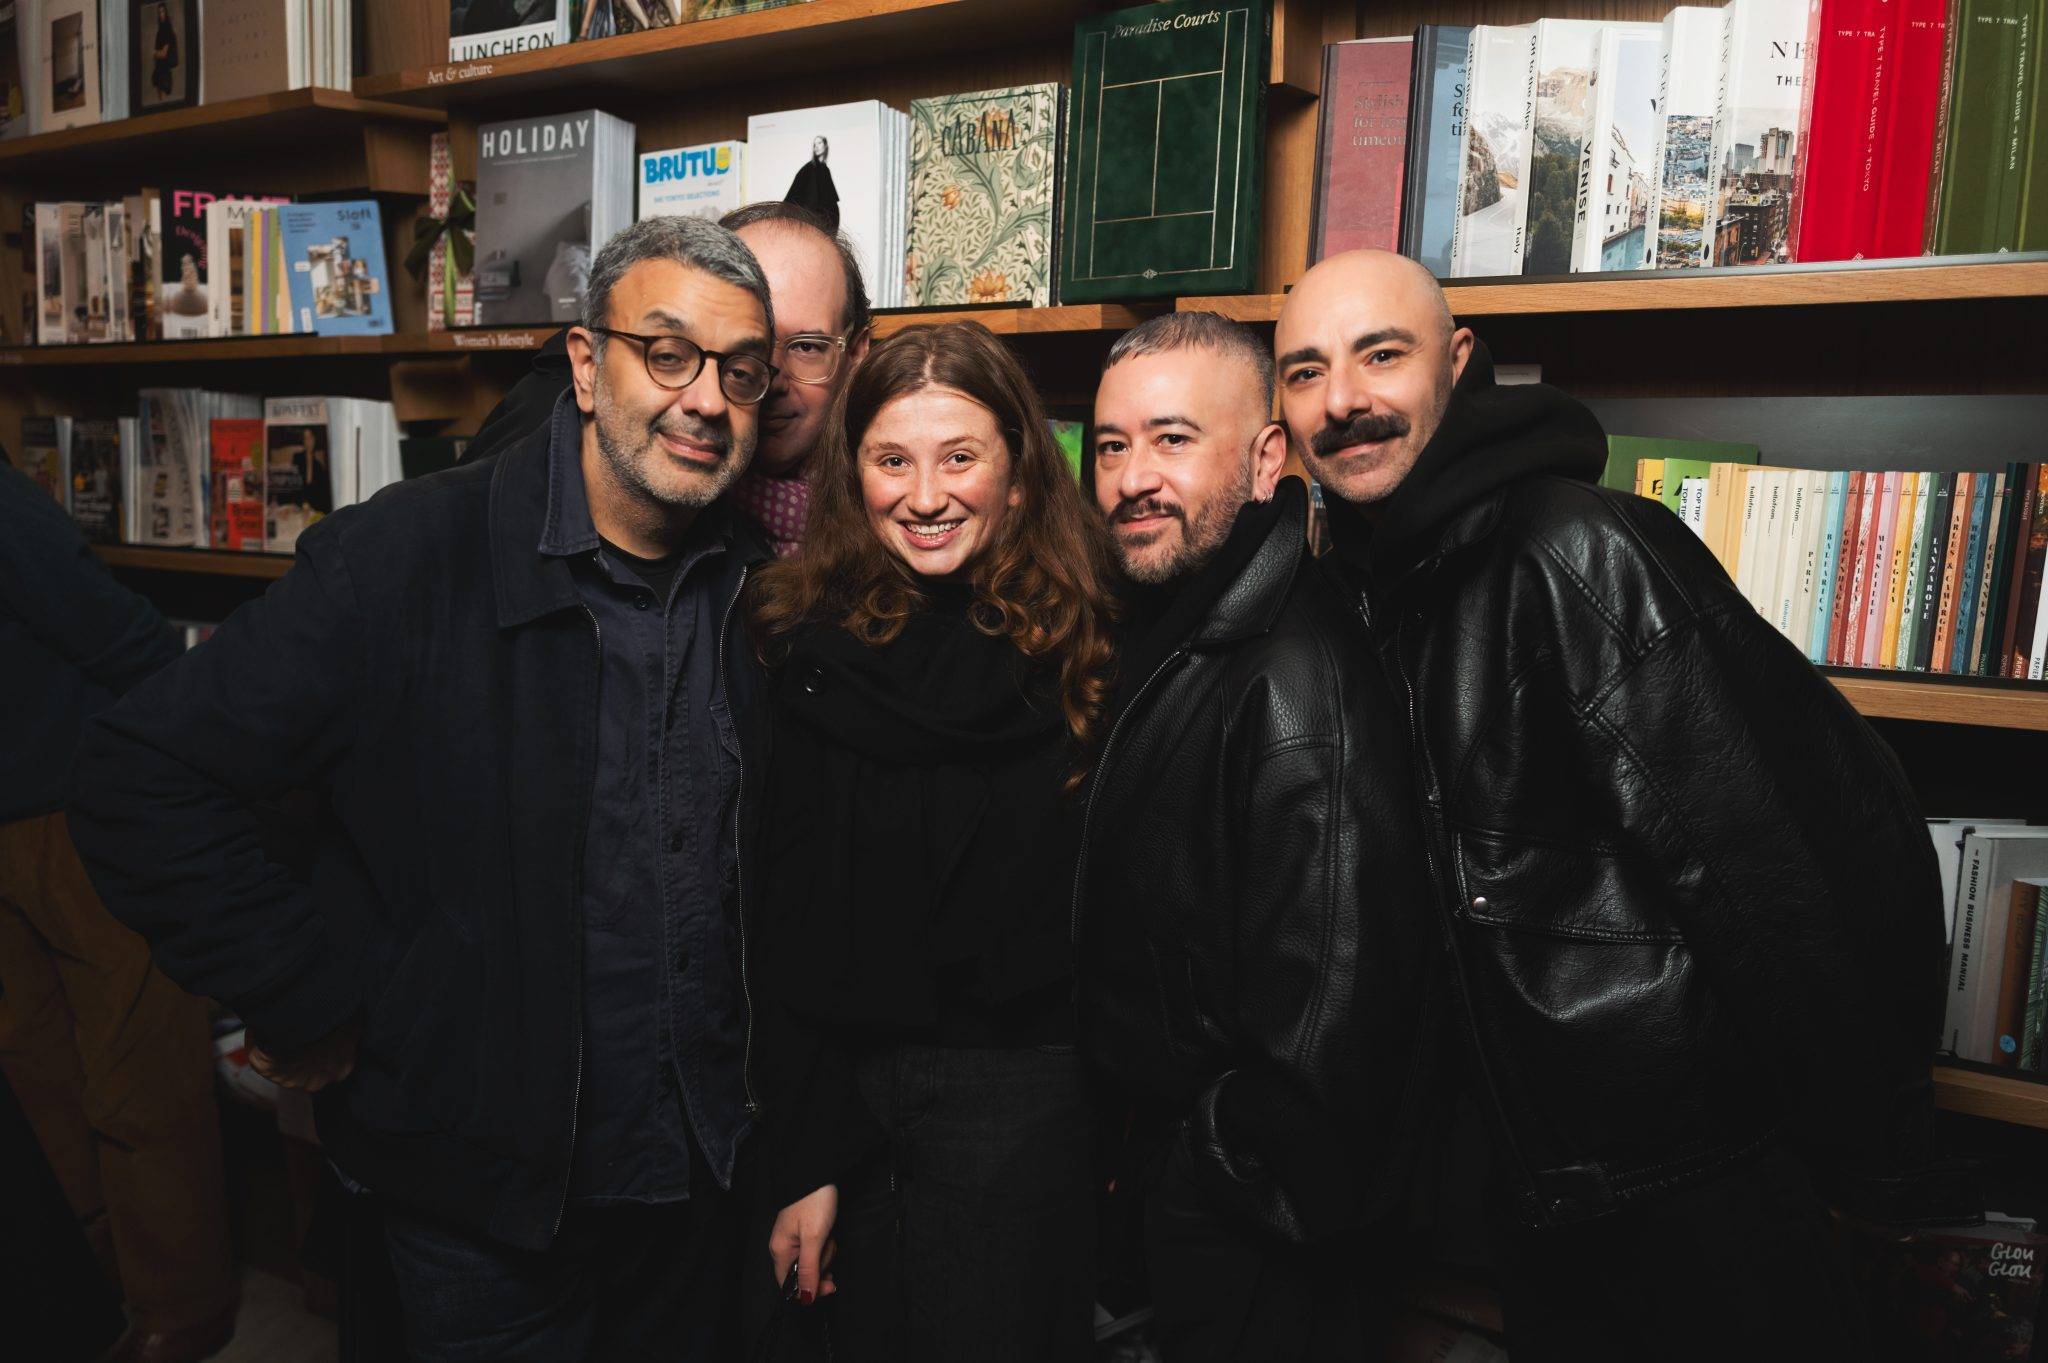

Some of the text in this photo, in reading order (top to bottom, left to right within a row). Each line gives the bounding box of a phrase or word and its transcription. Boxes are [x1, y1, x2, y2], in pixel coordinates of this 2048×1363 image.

[1111, 10, 1221, 39] Paradise Courts
[1876, 26, 1886, 53] TYPE
[450, 32, 555, 63] LUNCHEON
[428, 63, 493, 84] Art & culture
[1524, 35, 1537, 130] Off to the Alps
[1871, 64, 1882, 105] TRAVEL
[2016, 50, 2026, 88] TRAVEL
[2013, 90, 2023, 121] GUIDE
[482, 118, 590, 158] HOLIDAY
[941, 108, 1018, 156] CABANA
[1869, 107, 1878, 140] GUIDE
[2009, 138, 2018, 169] MILAN
[1578, 140, 1592, 223] VENISE
[1863, 156, 1873, 192] TOKYO
[1513, 226, 1522, 253] Italy
[453, 333, 535, 348] Women's lifestyle
[1681, 487, 1689, 504] TOP
[1695, 487, 1703, 504] TOP
[1747, 486, 1756, 519] hellofrom
[1770, 486, 1779, 519] hellofrom
[1794, 487, 1803, 521] hellofrom
[1949, 515, 1960, 556] ARLES
[1804, 551, 1814, 593] PARIS
[1818, 533, 1832, 612] BALEARICS
[1834, 530, 1849, 618] COPENHAGEN
[1870, 535, 1885, 616] MARSEILLE
[1891, 549, 1902, 603] PUGLIA
[1922, 537, 1939, 620] LANZAROTE
[1937, 575, 1952, 642] CAMARGUE
[2013, 656, 2024, 679] PAPIER
[2031, 656, 2041, 679] PAPIER
[1957, 859, 1980, 992] FASHION BUSINESS MANUAL
